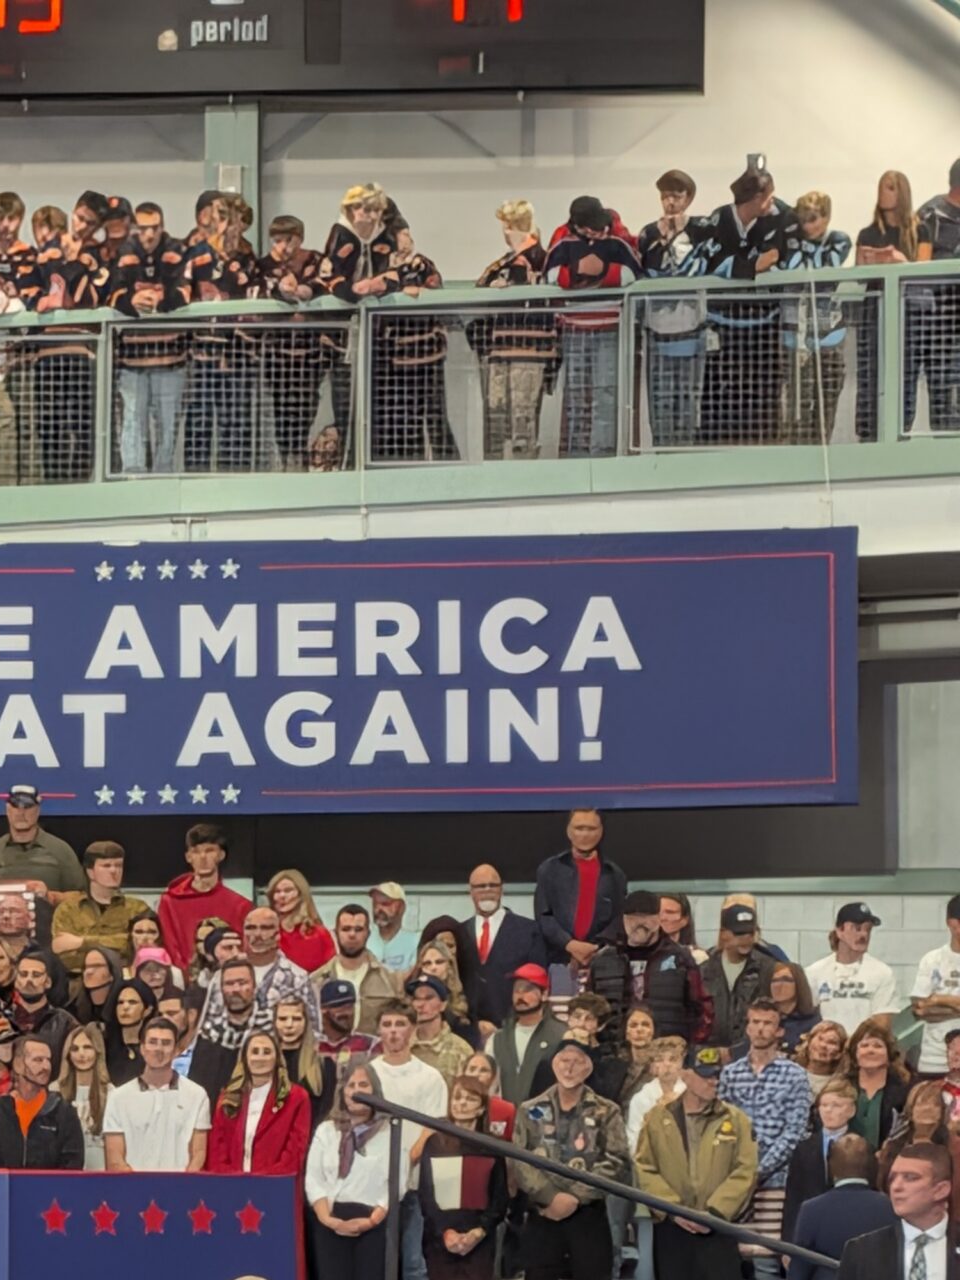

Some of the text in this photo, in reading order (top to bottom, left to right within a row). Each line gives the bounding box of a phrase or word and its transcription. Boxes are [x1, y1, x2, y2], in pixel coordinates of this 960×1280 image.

[190, 14, 269, 47] period
[84, 596, 642, 679] AMERICA
[175, 686, 603, 767] AGAIN!
